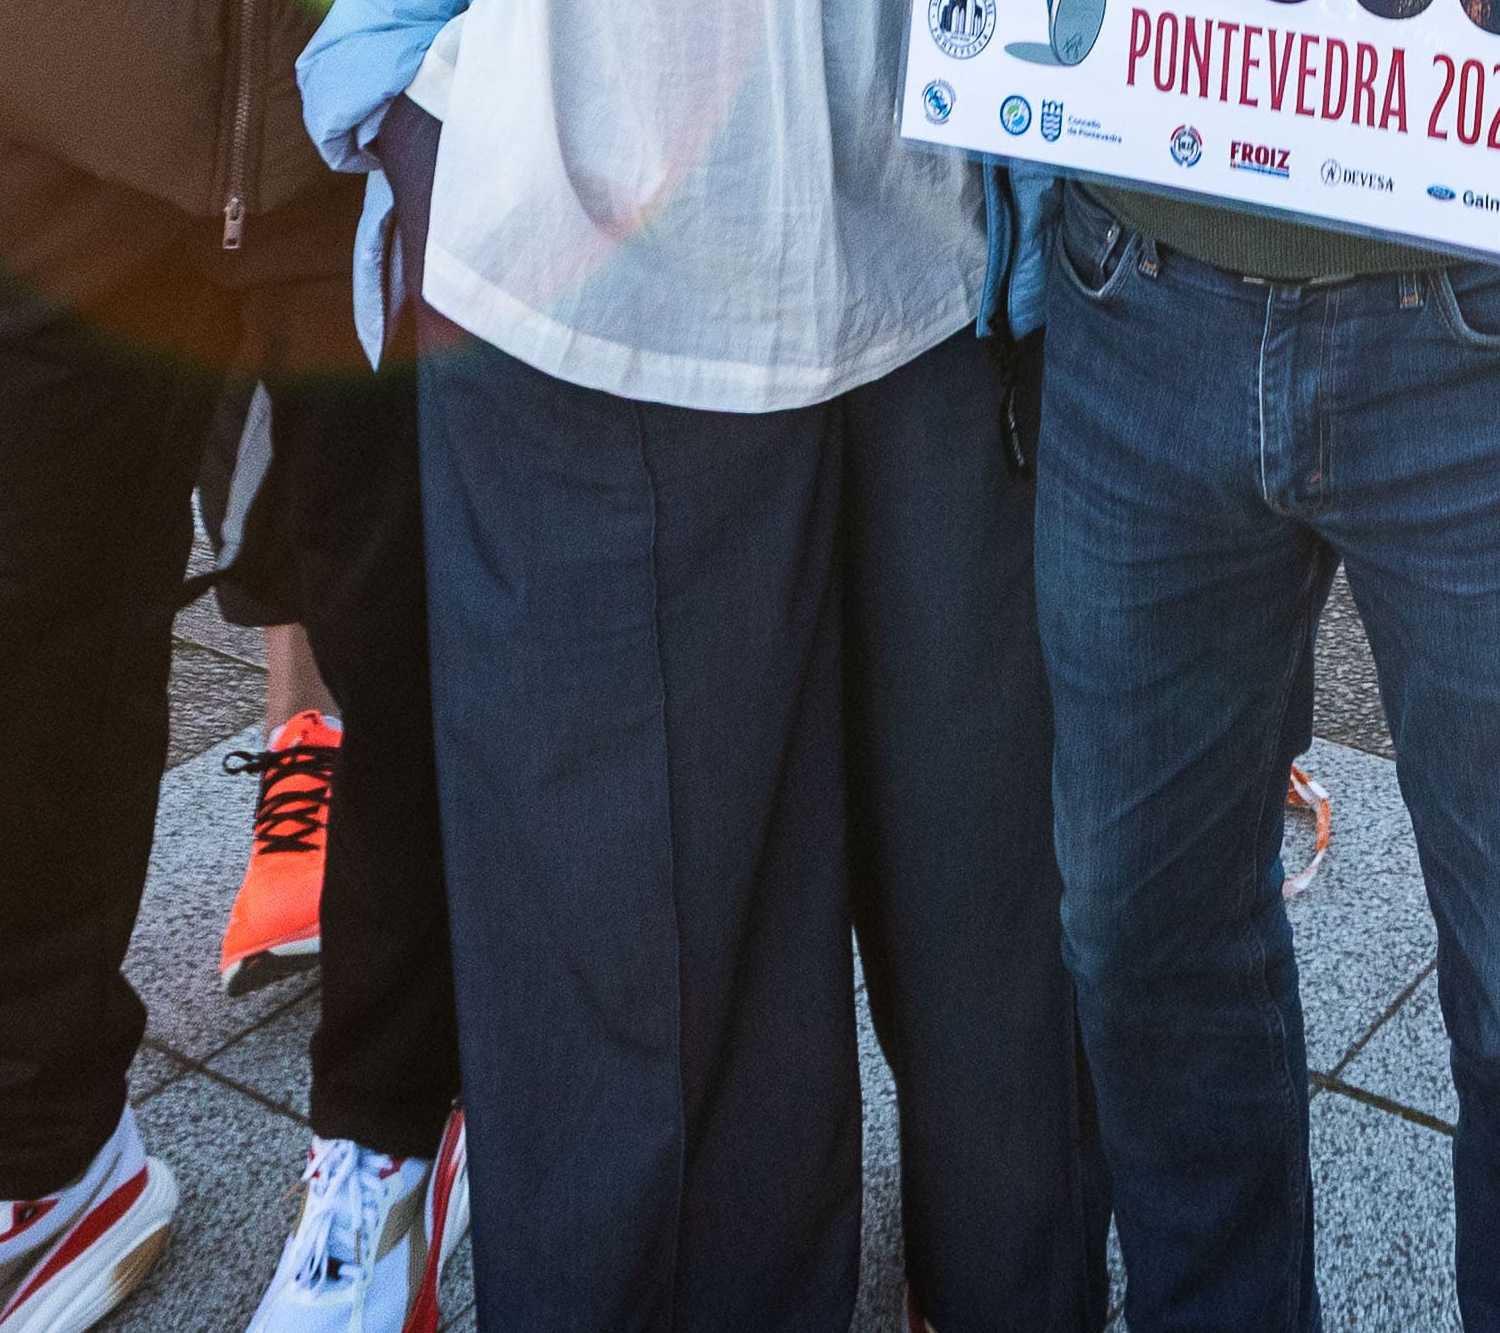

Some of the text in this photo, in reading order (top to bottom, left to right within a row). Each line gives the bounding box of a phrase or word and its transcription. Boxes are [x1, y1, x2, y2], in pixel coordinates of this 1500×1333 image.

[1126, 6, 1409, 135] PONTEVEDRA
[1230, 140, 1291, 170] FROIZ
[1343, 167, 1396, 193] DEVESA
